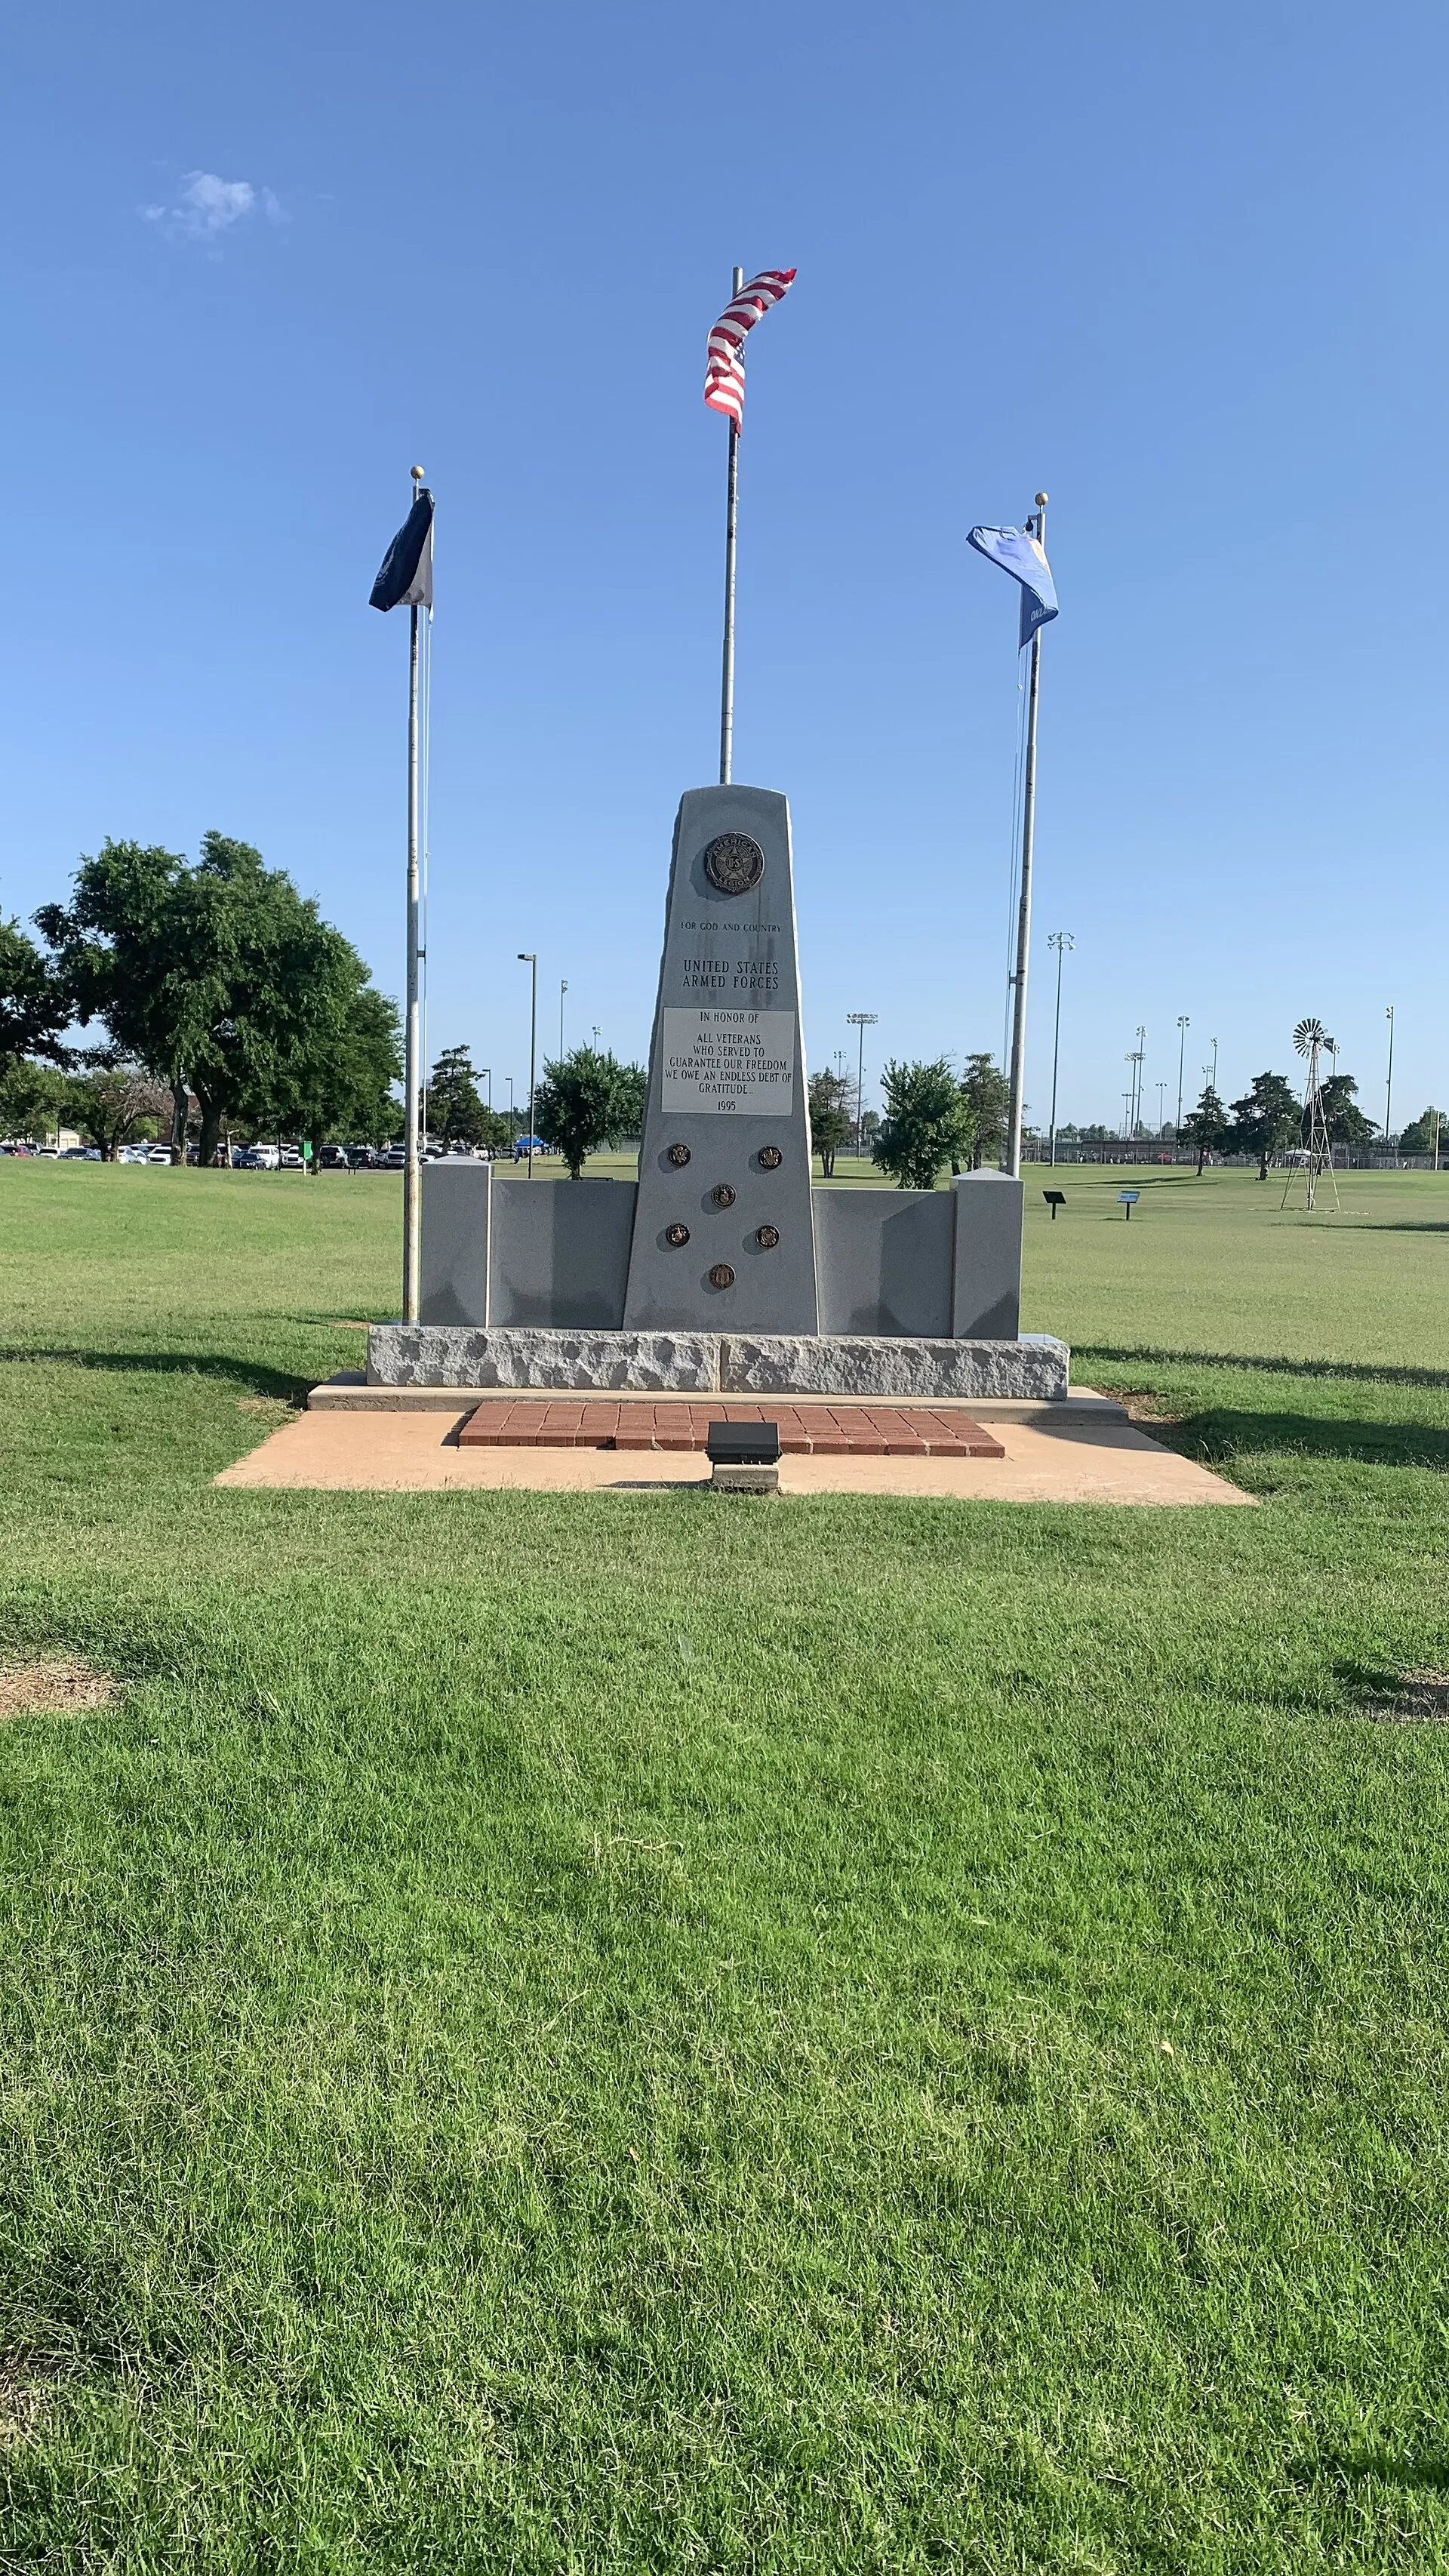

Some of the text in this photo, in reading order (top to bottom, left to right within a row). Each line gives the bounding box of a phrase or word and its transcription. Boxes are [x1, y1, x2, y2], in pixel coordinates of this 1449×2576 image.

[713, 839, 756, 858] AMERICAN
[718, 876, 750, 887] LEGION
[700, 922, 718, 931] GOD
[743, 924, 782, 933] COUNTRY
[684, 959, 778, 974] UNITED STATES
[682, 974, 779, 989] ARMED FORCES
[700, 1011, 760, 1023] IN HONOR OF
[697, 1033, 761, 1045] ALL VETERANS
[693, 1045, 765, 1057] WHO SERVED TO
[669, 1057, 787, 1070] GUARANTEE OUR FREEDOM
[665, 1069, 792, 1083] WE OWE AN ENDLESS DEBT OF
[718, 1100, 737, 1111] 1995
